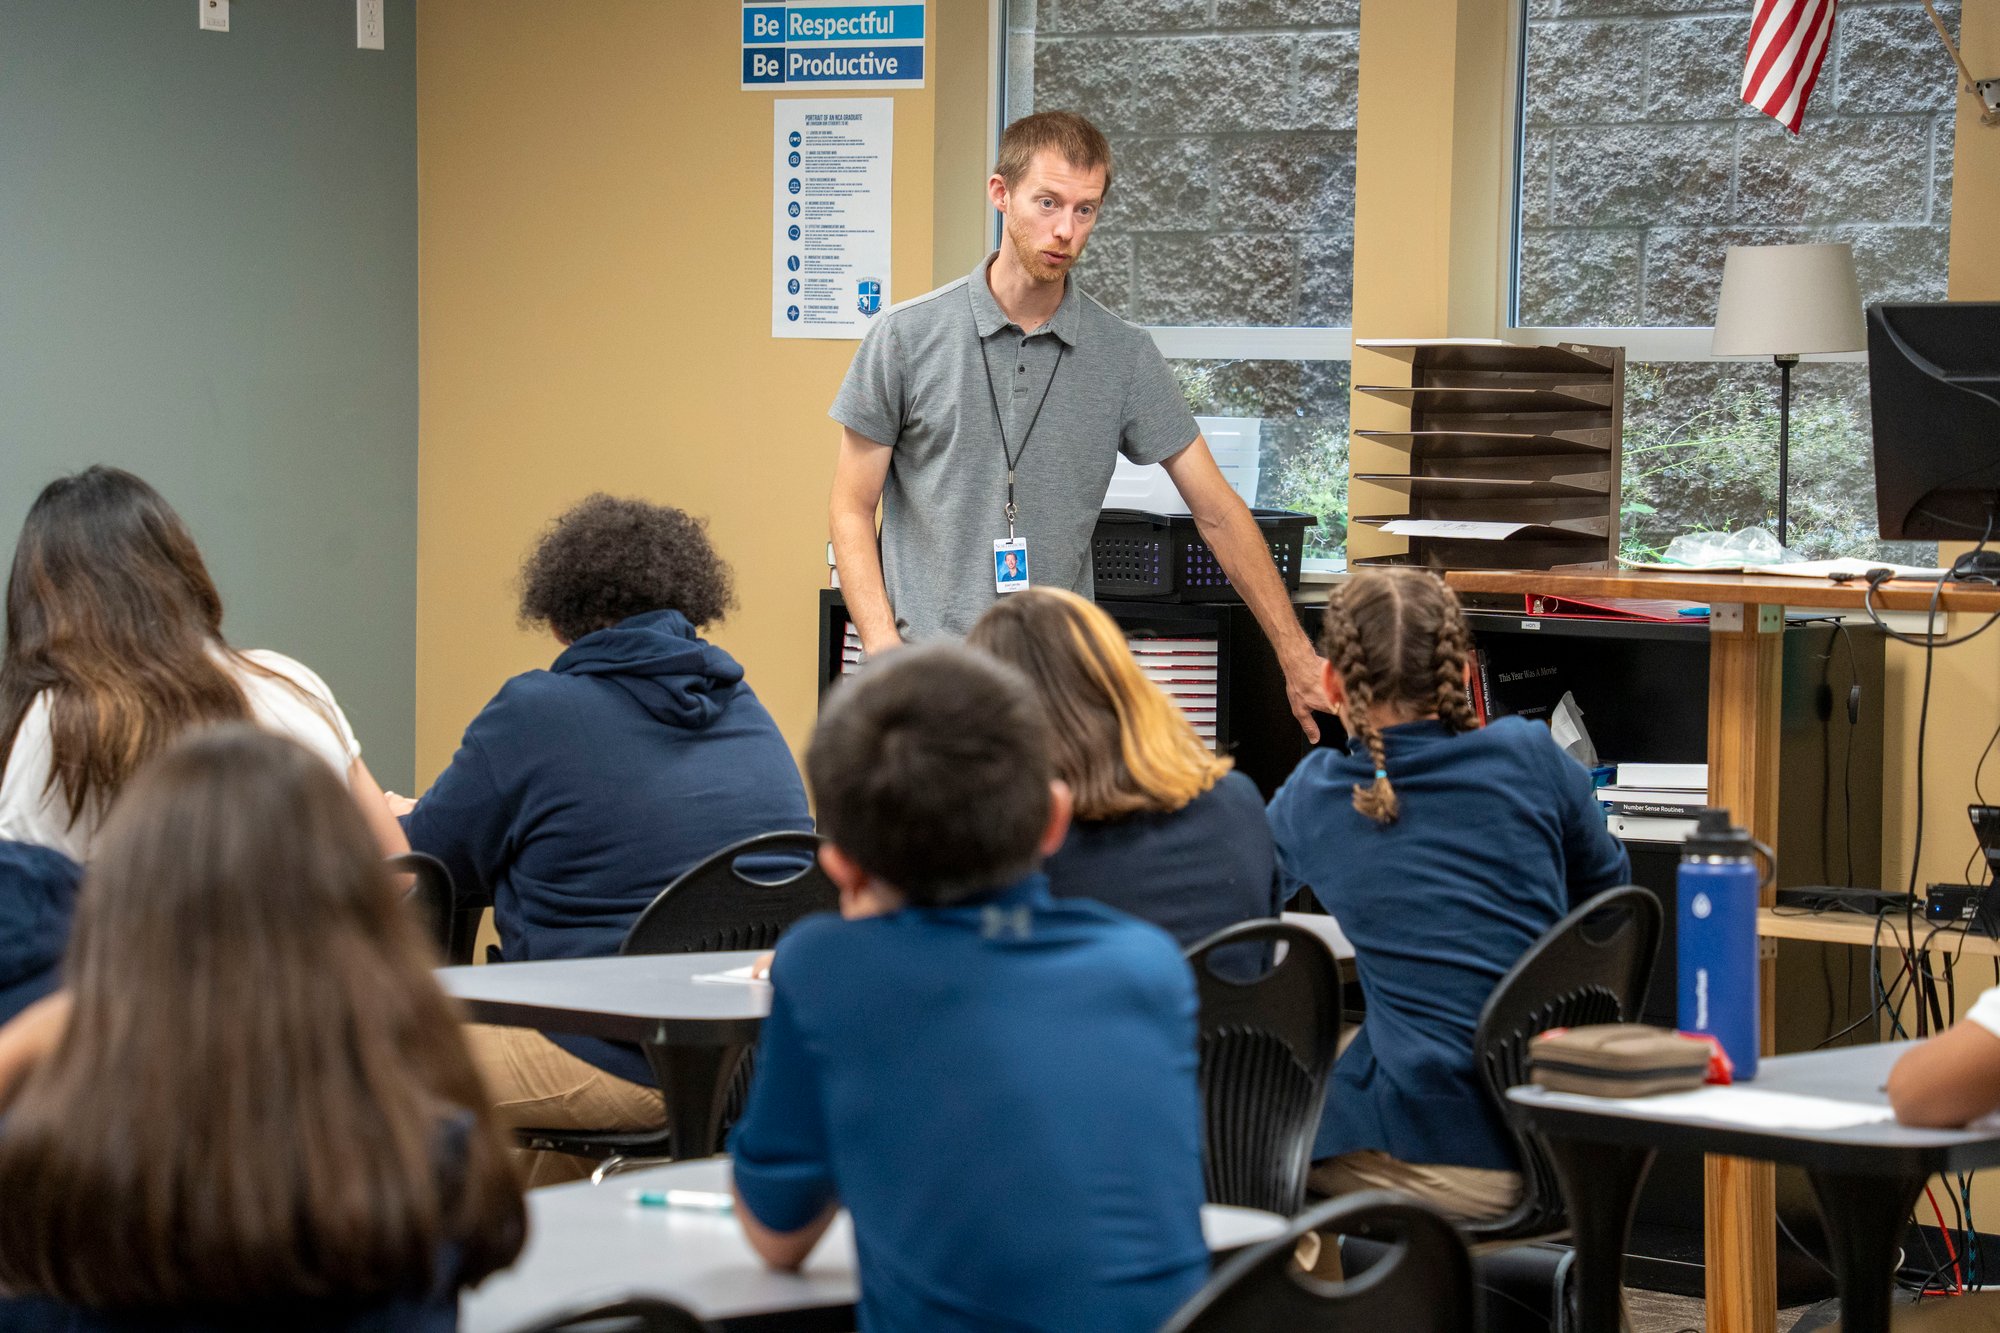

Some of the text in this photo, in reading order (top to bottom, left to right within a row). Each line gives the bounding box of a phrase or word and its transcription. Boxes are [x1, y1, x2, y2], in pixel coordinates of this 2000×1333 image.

[753, 10, 894, 39] Be Respectful
[753, 51, 898, 77] Be Productive
[1498, 673, 1511, 682] This
[1511, 672, 1523, 681] Year
[1523, 670, 1535, 678] Was
[1540, 666, 1557, 676] Movie
[1660, 805, 1684, 813] Routines
